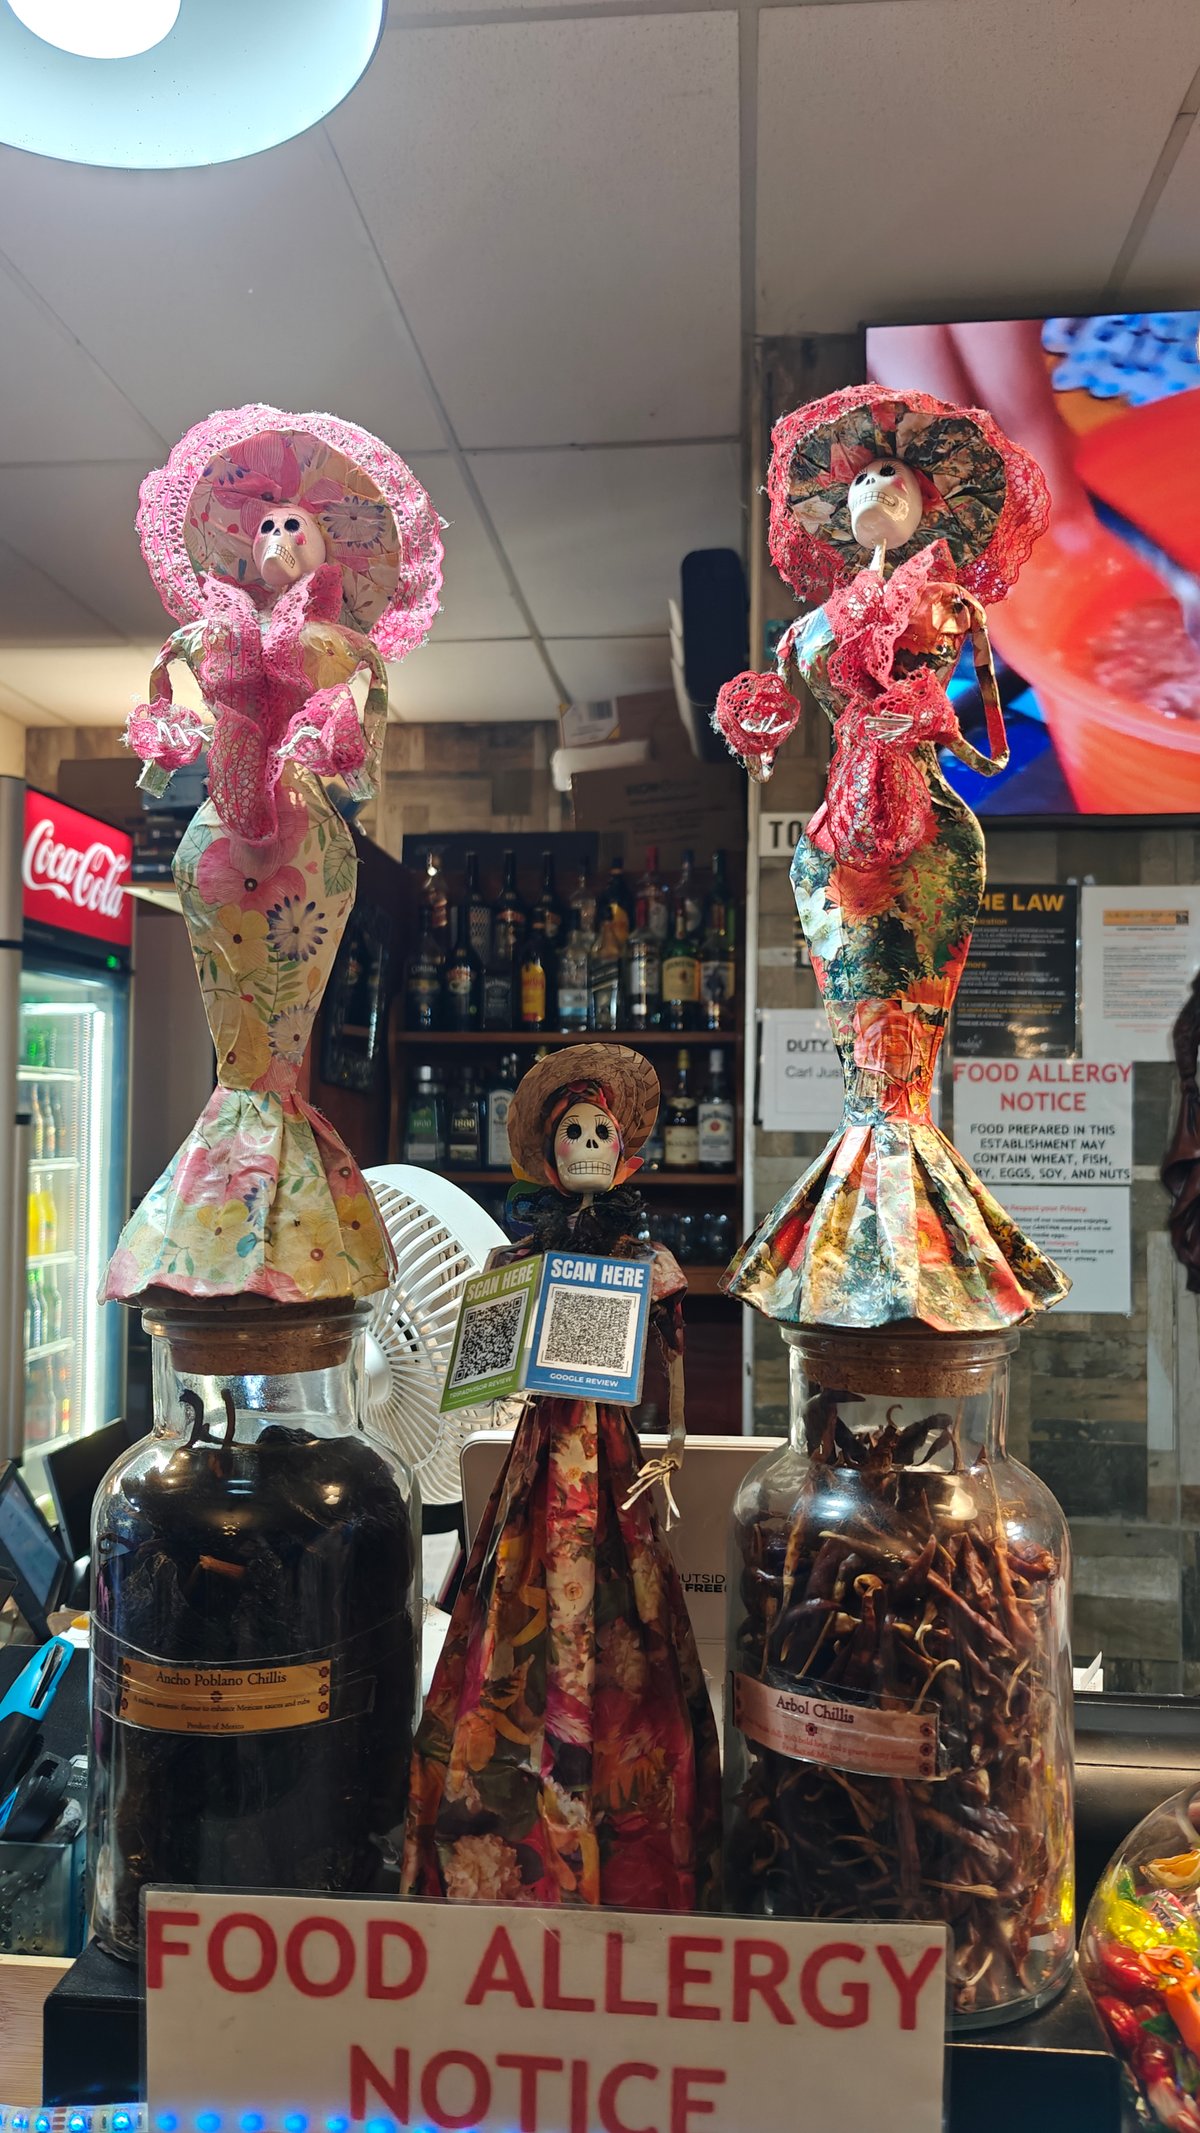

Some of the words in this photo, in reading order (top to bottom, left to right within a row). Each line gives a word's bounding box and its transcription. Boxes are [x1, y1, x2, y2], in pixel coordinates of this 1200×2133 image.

[22, 819, 131, 919] Coca-Cola
[979, 893, 1005, 911] HE
[1012, 893, 1064, 911] LAW
[787, 1039, 829, 1052] DUTY
[785, 1065, 812, 1078] Carl
[953, 1063, 1019, 1083] FOOD
[1027, 1063, 1132, 1083] ALLERGY
[1000, 1092, 1087, 1111] NOTICE
[454, 1118, 475, 1128] 1800
[970, 1124, 1004, 1135] FOOD
[1008, 1124, 1069, 1135] PREPARED
[1073, 1124, 1085, 1135] IN
[1090, 1124, 1115, 1136] THIS
[980, 1138, 1077, 1149] ESTABLISHMENT
[1080, 1139, 1106, 1150] MAY
[973, 1153, 1027, 1164] CONTAIN
[1031, 1153, 1078, 1165] WHEAT,
[1082, 1153, 1112, 1165] FISH,
[1000, 1168, 1035, 1180] EGGS,
[1040, 1168, 1067, 1180] SOY,
[1071, 1168, 1096, 1179] AND
[1099, 1168, 1130, 1179] NUTS
[551, 1258, 597, 1283] SCAN
[601, 1264, 645, 1288] HERE
[467, 1279, 499, 1302] SCAN
[502, 1263, 535, 1291] HERE
[550, 1372, 584, 1384] GOOGLE
[585, 1376, 619, 1388] REVIEW
[680, 1573, 726, 1584] UTSID
[685, 1583, 722, 1593] FREE
[156, 1671, 190, 1686] Ancho
[194, 1674, 243, 1687] Poblano
[247, 1671, 287, 1686] Chillis
[284, 1700, 296, 1708] and
[776, 1695, 810, 1716] Arbol
[812, 1702, 855, 1724] Chillis
[145, 1909, 428, 2000] FOOD
[465, 1926, 942, 2032] ALLERGY
[349, 2044, 727, 2133] NOTICE
